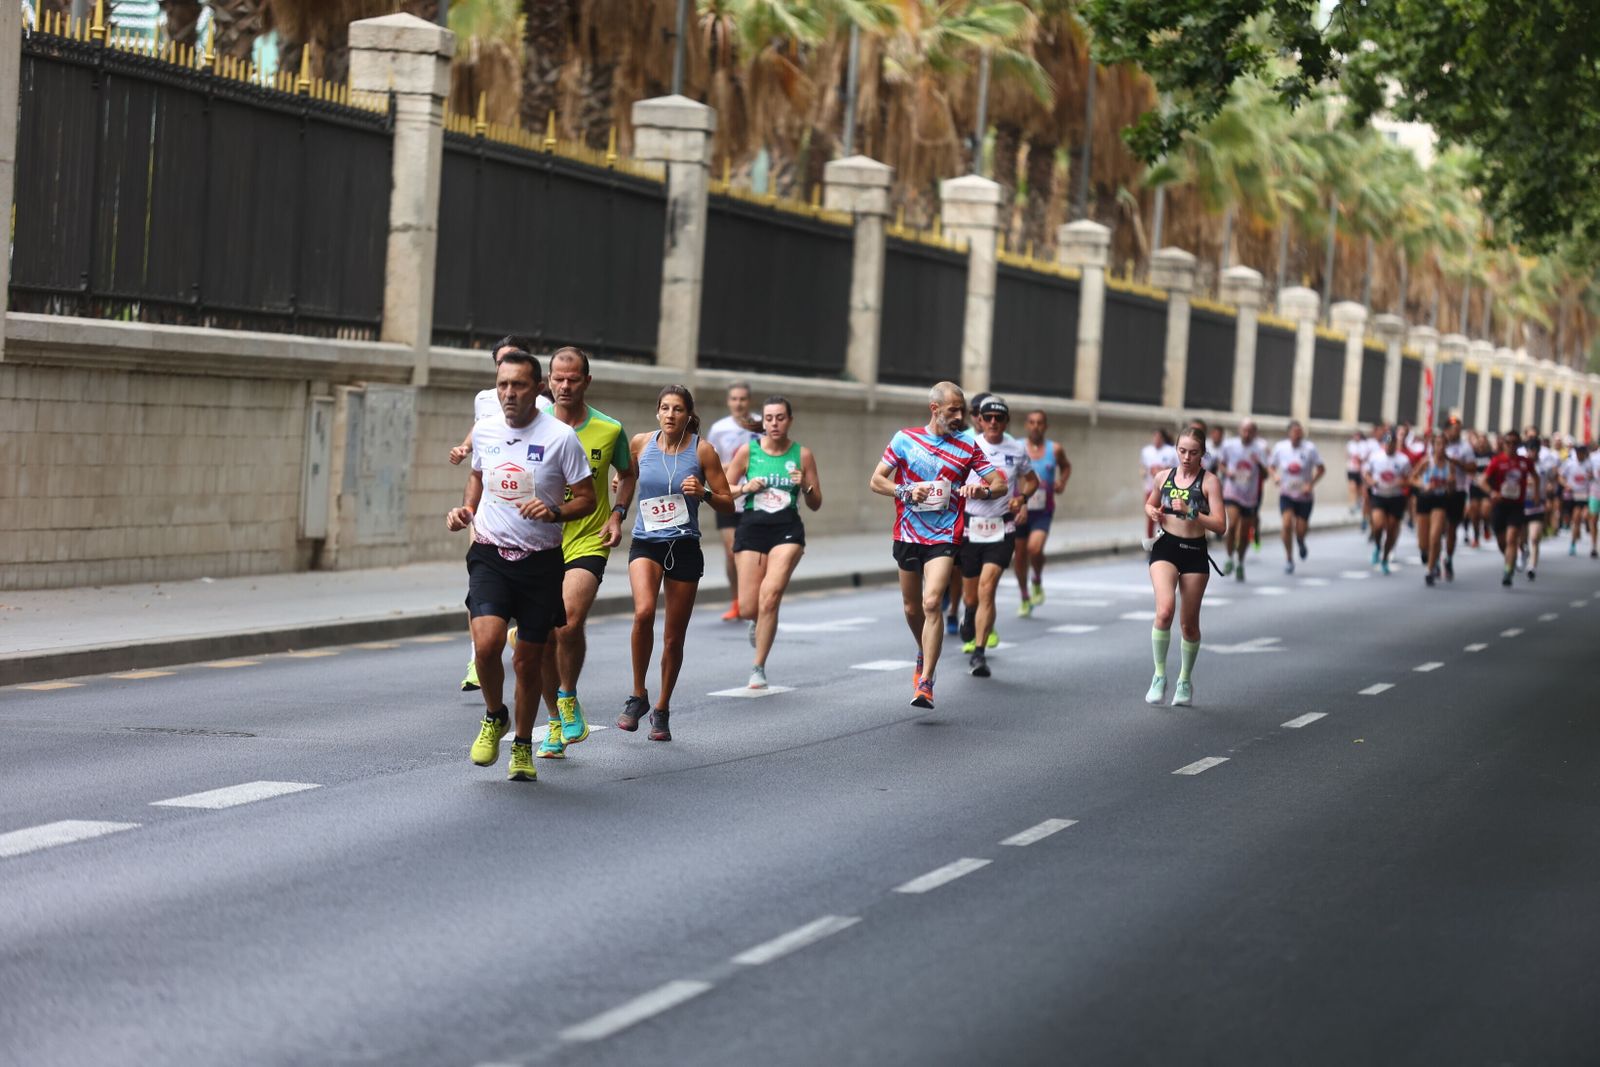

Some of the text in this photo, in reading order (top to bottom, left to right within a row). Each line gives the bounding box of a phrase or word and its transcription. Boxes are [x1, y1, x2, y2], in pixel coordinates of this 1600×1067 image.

[501, 479, 518, 490] 68
[929, 488, 943, 497] 28
[651, 503, 676, 516] 318
